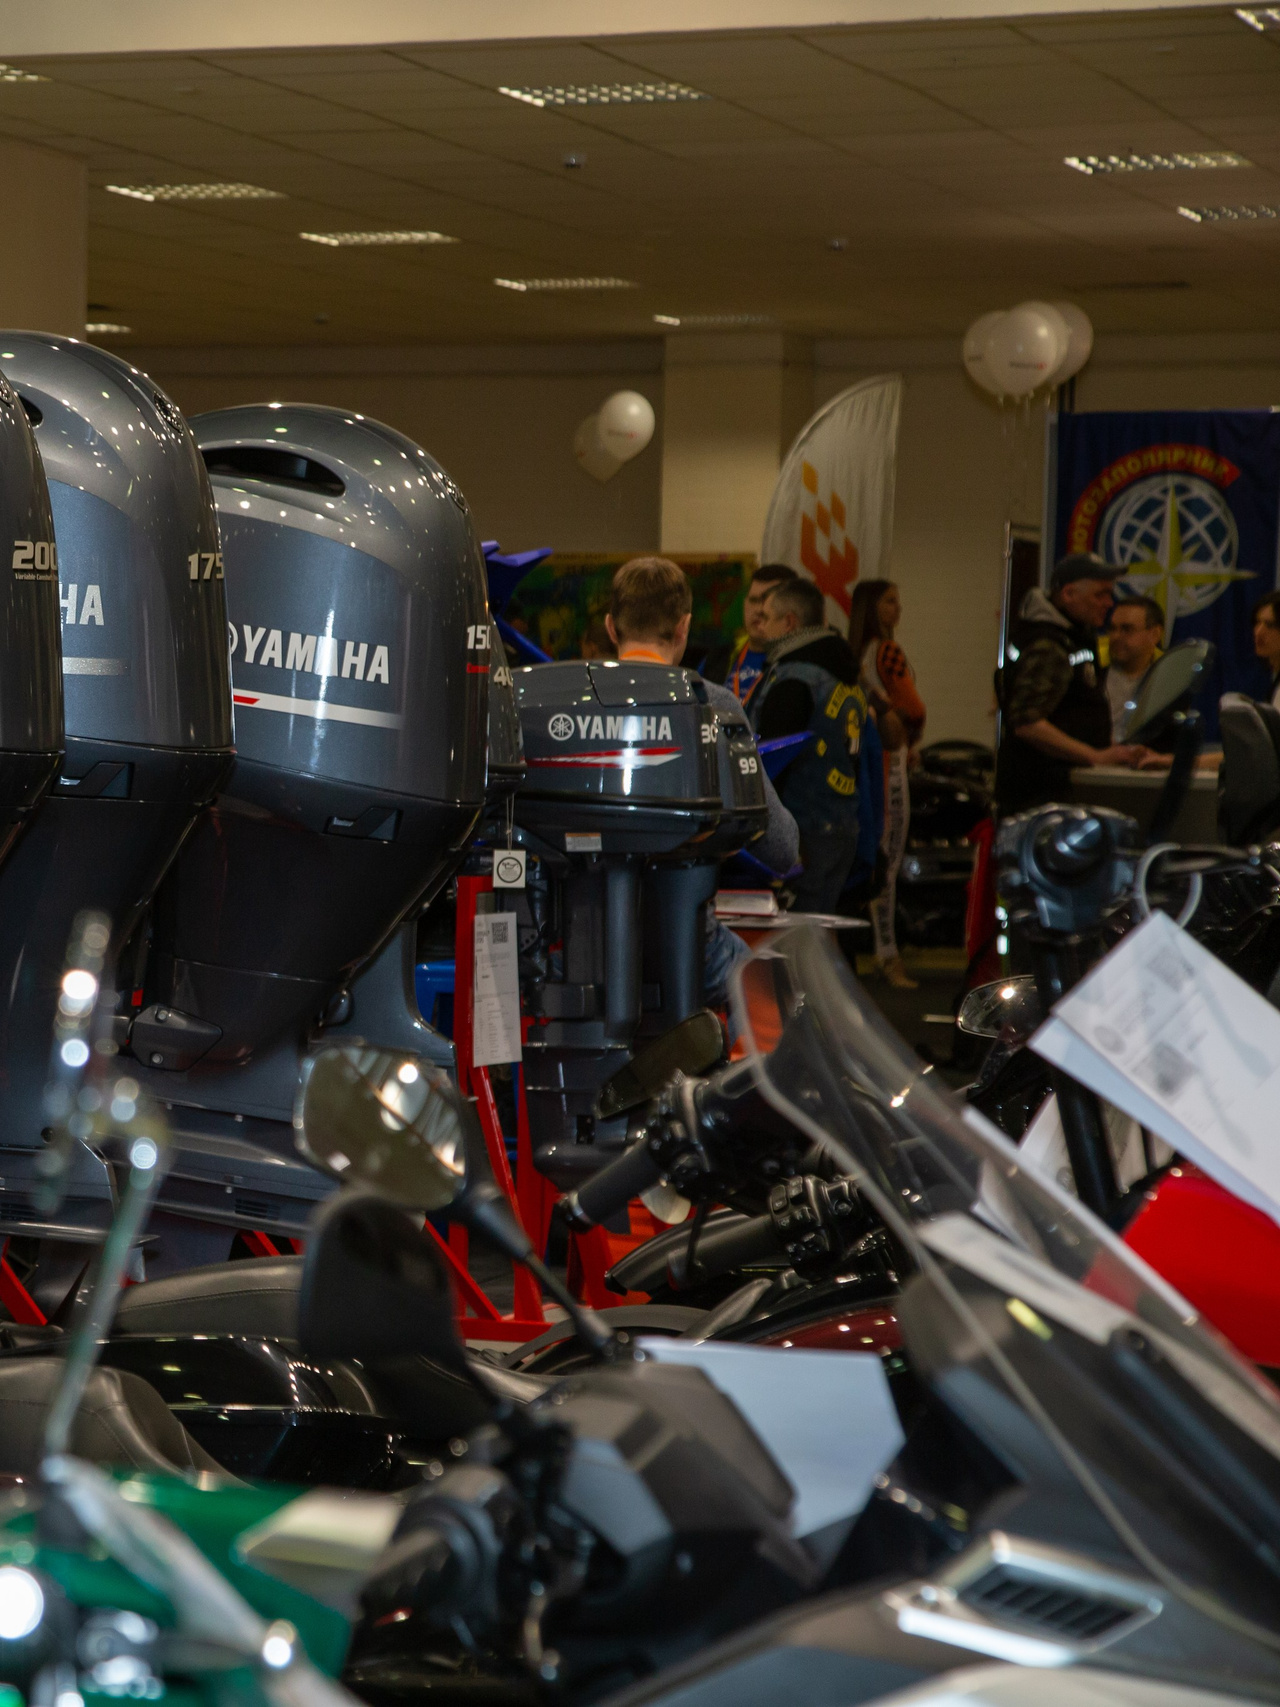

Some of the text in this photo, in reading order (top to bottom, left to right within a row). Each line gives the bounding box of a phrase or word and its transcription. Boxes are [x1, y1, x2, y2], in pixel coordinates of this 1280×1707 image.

[187, 552, 225, 581] 175
[243, 624, 389, 684] YAMAHA
[576, 715, 673, 741] YAMAHA
